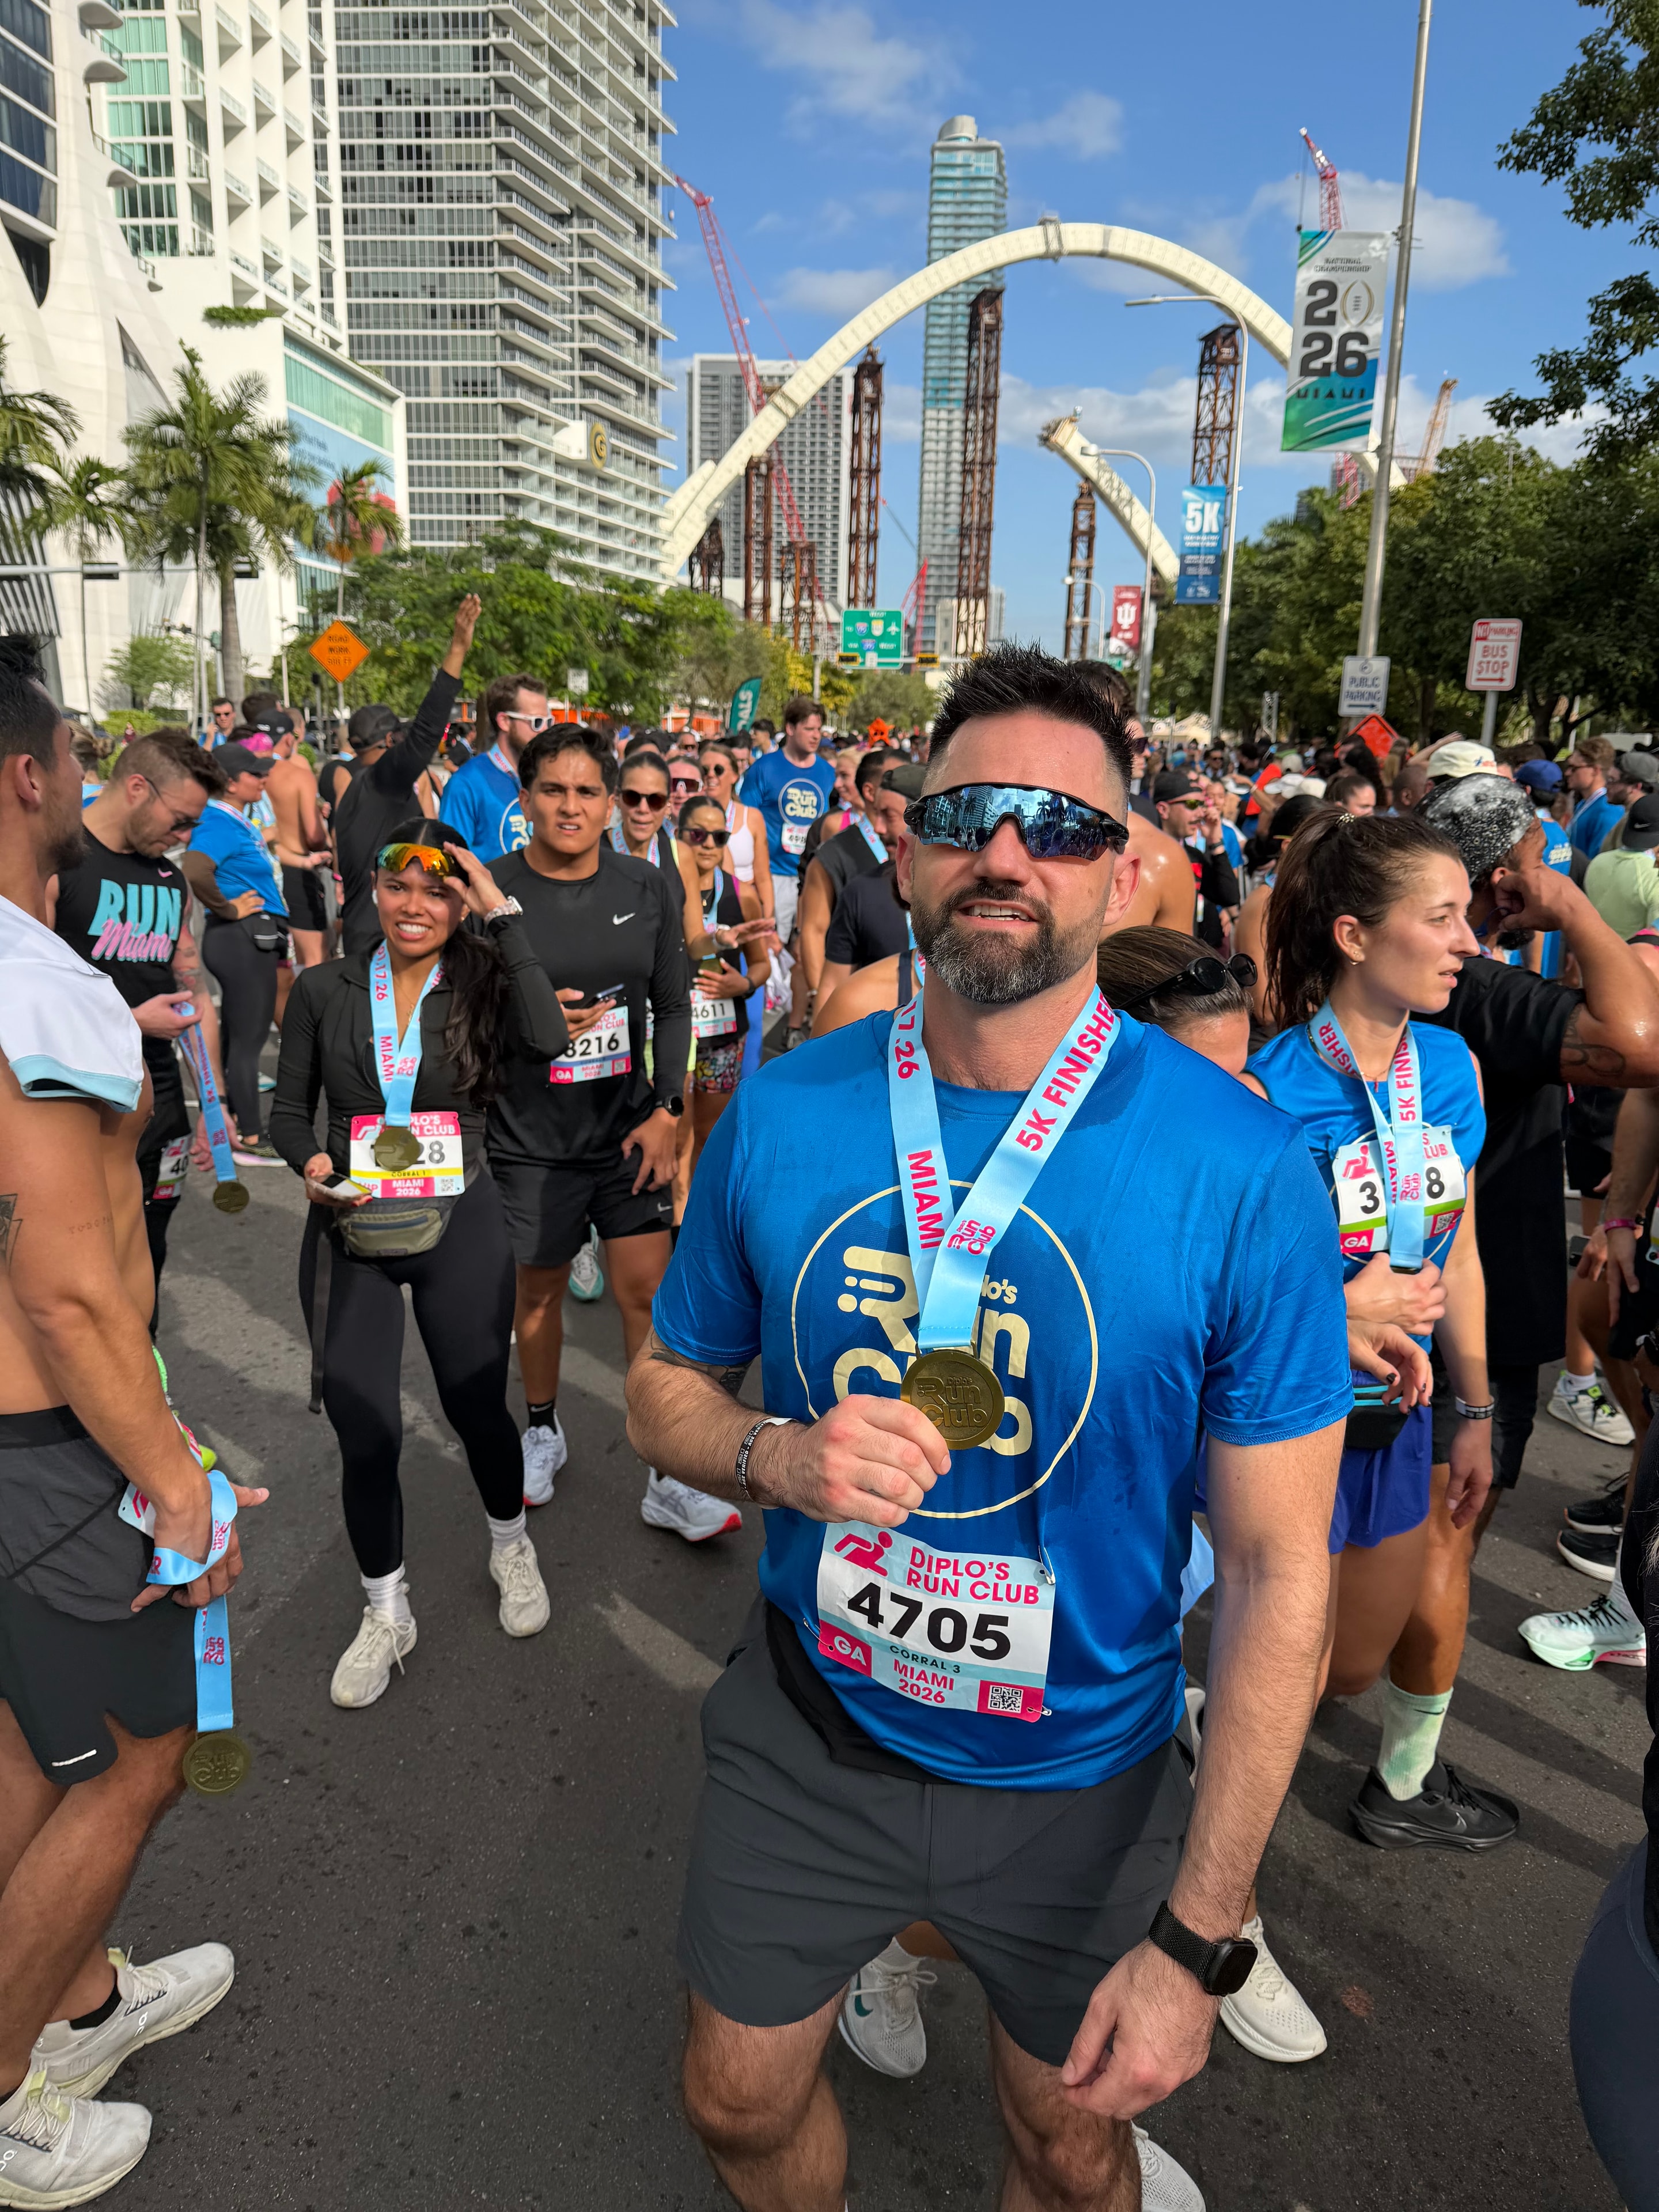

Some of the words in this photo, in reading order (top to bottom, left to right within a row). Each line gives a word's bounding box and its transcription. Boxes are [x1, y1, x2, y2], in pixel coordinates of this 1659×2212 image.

[1300, 331, 1369, 378] 26
[1296, 388, 1366, 399] MIAMI
[1185, 501, 1221, 534] 5K
[1482, 645, 1508, 658] BUS
[1477, 661, 1510, 675] STOP
[785, 802, 817, 819] Club
[787, 787, 817, 806] Run
[87, 878, 182, 941] RUN
[91, 918, 173, 964] Miami
[605, 1018, 625, 1030] CLUB
[380, 1035, 393, 1083] MIAMI
[564, 1033, 619, 1058] 8216
[1394, 1036, 1415, 1089] FINIS
[1399, 1096, 1416, 1122] 5K
[423, 1124, 456, 1135] CLUB
[1015, 1107, 1058, 1152] 5K
[392, 1179, 425, 1188] MIAMI
[396, 1188, 421, 1196] 2026
[907, 1149, 945, 1250] MIAMI
[947, 1219, 982, 1249] Run
[967, 1225, 997, 1255] Club
[1344, 1236, 1369, 1248] GA
[980, 1274, 1018, 1304] lo's
[915, 1376, 981, 1405] Run
[921, 1403, 988, 1429] Club
[908, 1546, 1011, 1581] DIPLO'S
[906, 1569, 960, 1598] RUN
[969, 1580, 1040, 1605] CLUB
[847, 1581, 1012, 1661] 4705
[203, 1637, 215, 1663] Run
[214, 1637, 224, 1665] Club
[834, 1635, 866, 1666] GA
[889, 1645, 947, 1671] CORRAL
[952, 1664, 961, 1674] 3
[893, 1658, 955, 1691] MIAMI
[898, 1678, 946, 1705] 2026
